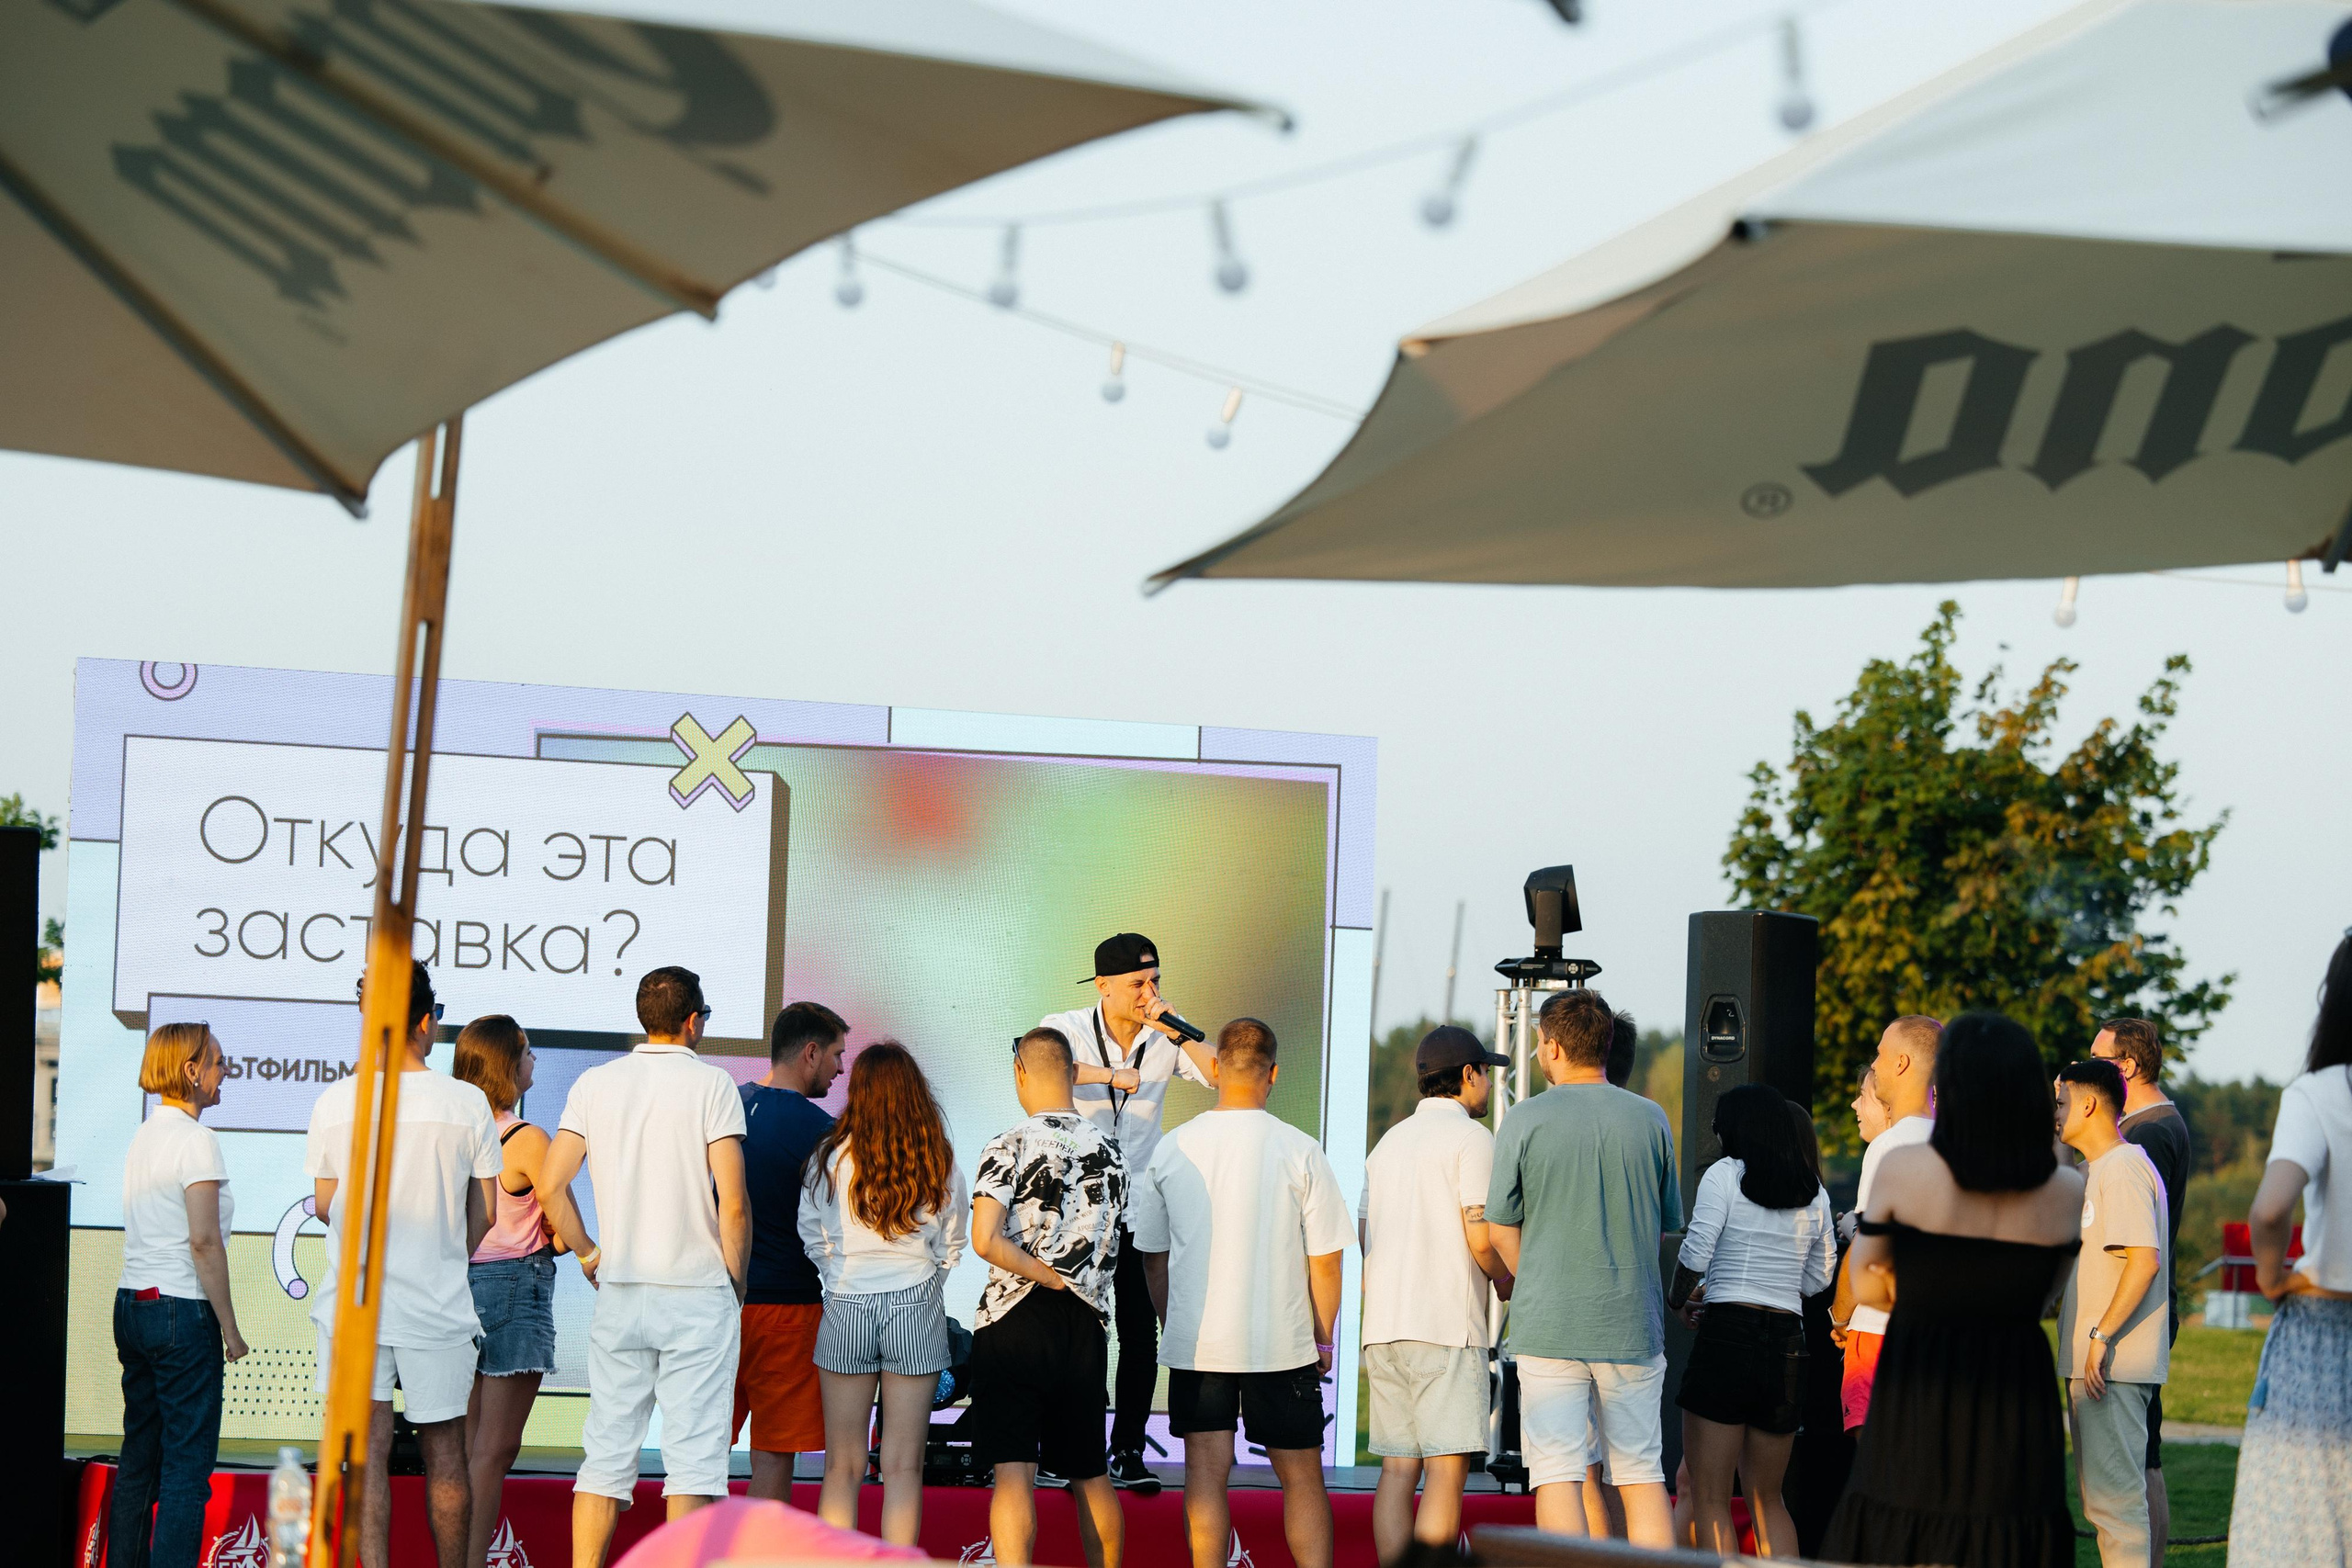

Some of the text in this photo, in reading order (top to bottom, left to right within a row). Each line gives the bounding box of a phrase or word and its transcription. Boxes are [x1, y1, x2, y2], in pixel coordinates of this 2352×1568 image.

[198, 795, 678, 887] Откуда эта
[222, 1055, 357, 1083] ЬТФИЛЬМ
[1035, 1138, 1075, 1156] KEEPER
